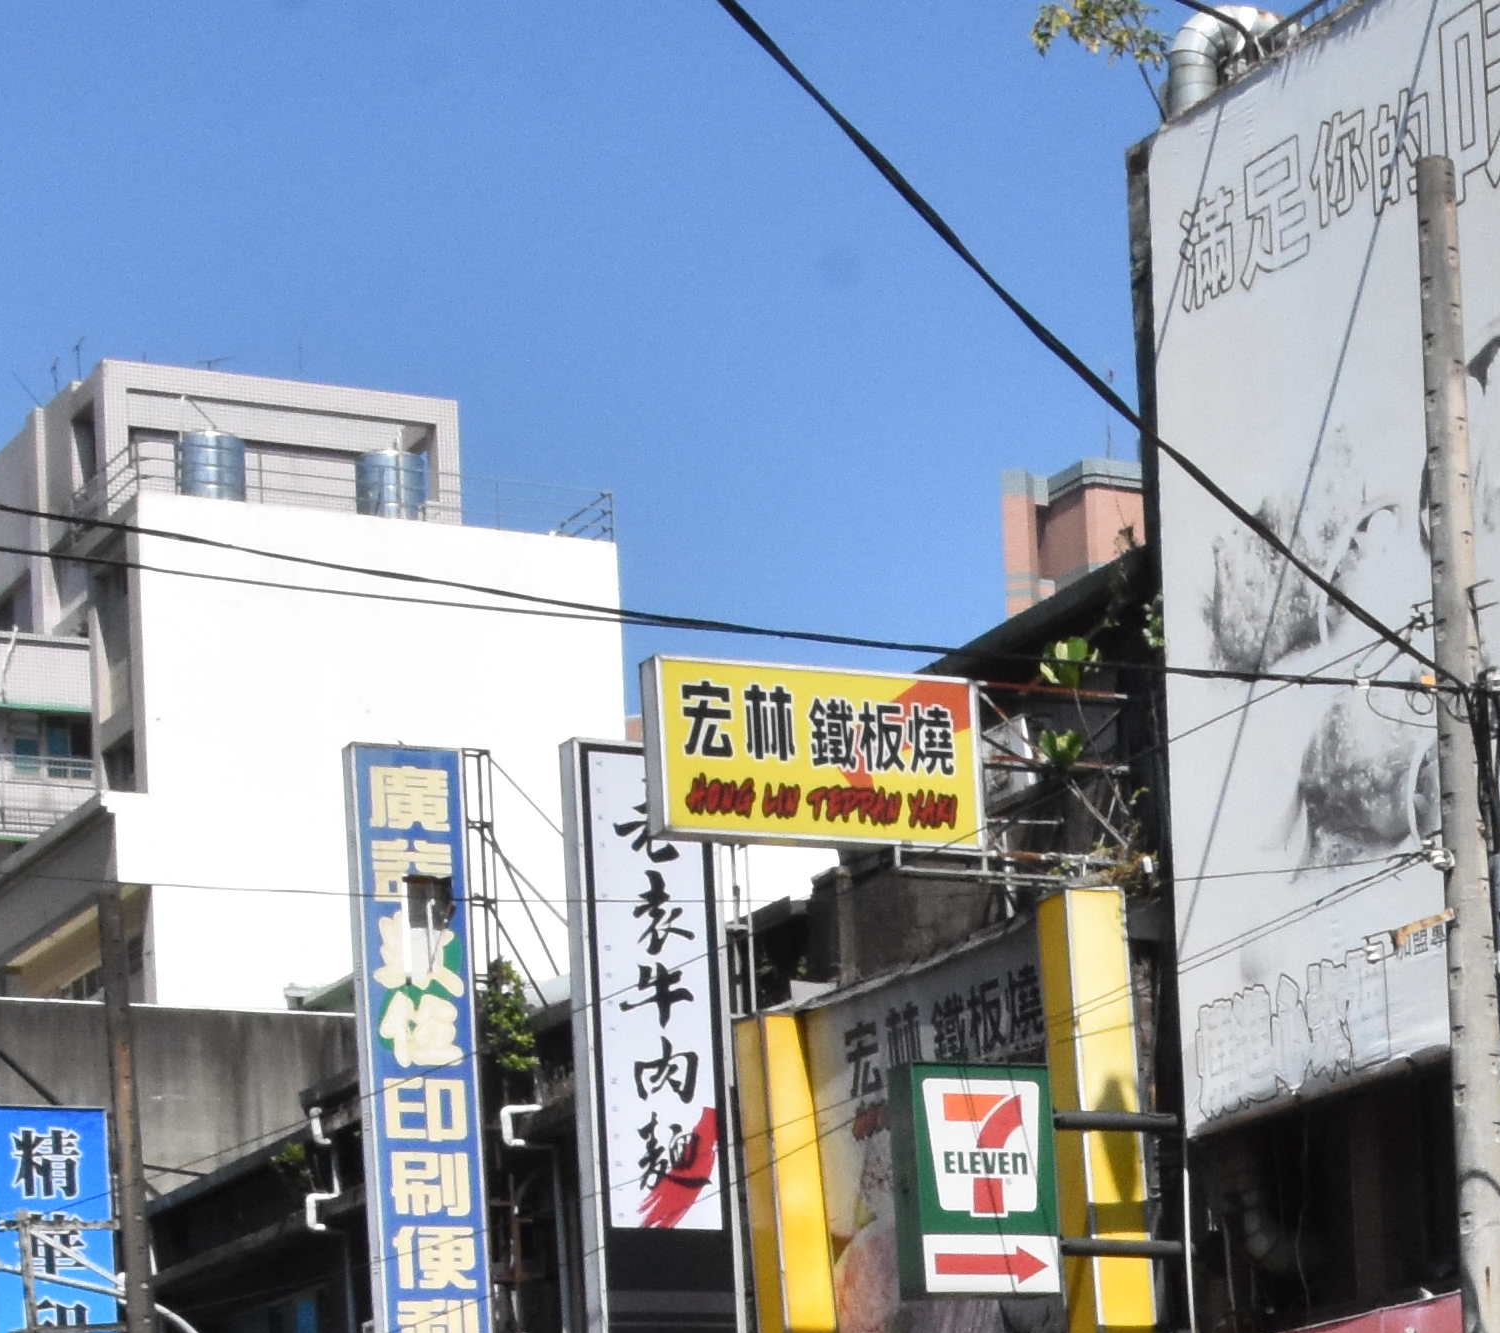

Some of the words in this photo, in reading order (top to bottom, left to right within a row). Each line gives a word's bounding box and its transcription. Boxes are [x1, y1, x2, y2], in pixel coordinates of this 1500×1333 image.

[681, 679, 955, 777] 宏林鐵板燒
[685, 772, 757, 818] HONG
[762, 782, 801, 819] LIN
